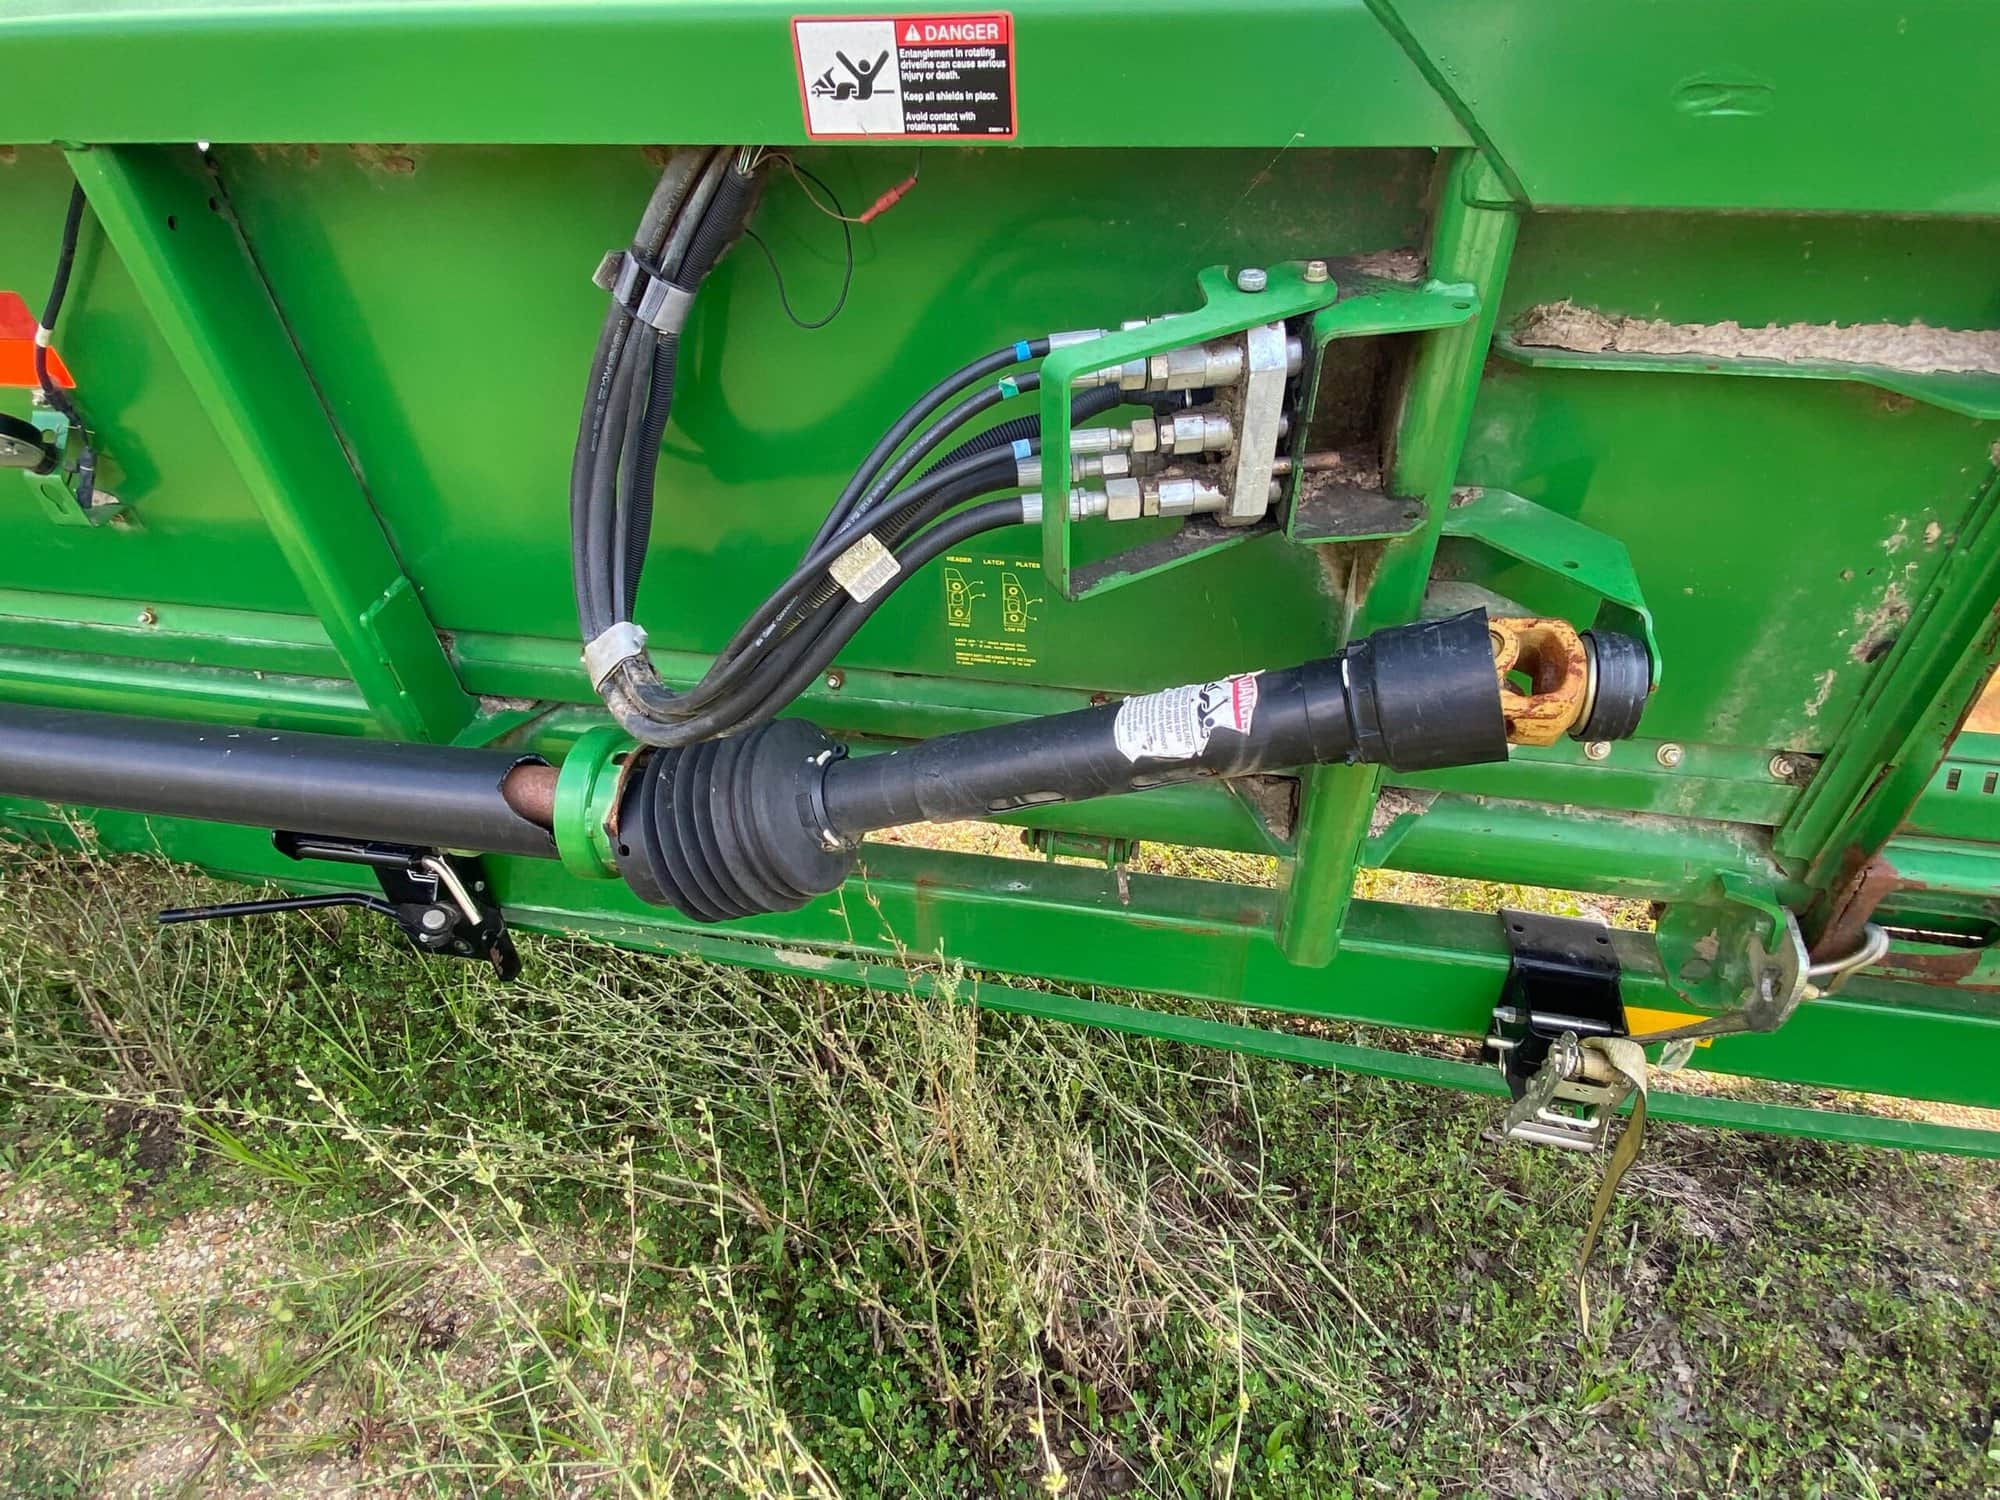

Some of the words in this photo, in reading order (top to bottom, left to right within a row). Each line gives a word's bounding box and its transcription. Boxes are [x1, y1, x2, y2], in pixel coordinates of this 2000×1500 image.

[924, 23, 999, 42] DANGER
[899, 48, 954, 59] Entanglement
[955, 48, 963, 57] in
[964, 47, 995, 59] rotating
[900, 60, 934, 69] driveline
[952, 60, 975, 68] cause
[977, 59, 1006, 68] serious
[901, 71, 924, 83] injury
[925, 72, 935, 80] or
[935, 70, 961, 80] death.
[903, 91, 924, 103] Keep
[925, 91, 935, 100] all
[936, 91, 964, 101] shields
[965, 91, 973, 101] in
[975, 90, 998, 103] place.
[905, 112, 928, 121] Avoid
[929, 112, 958, 121] contact
[959, 111, 976, 121] with
[906, 123, 936, 133] rotating
[937, 122, 960, 133] parts.
[1237, 675, 1256, 731] DANGE
